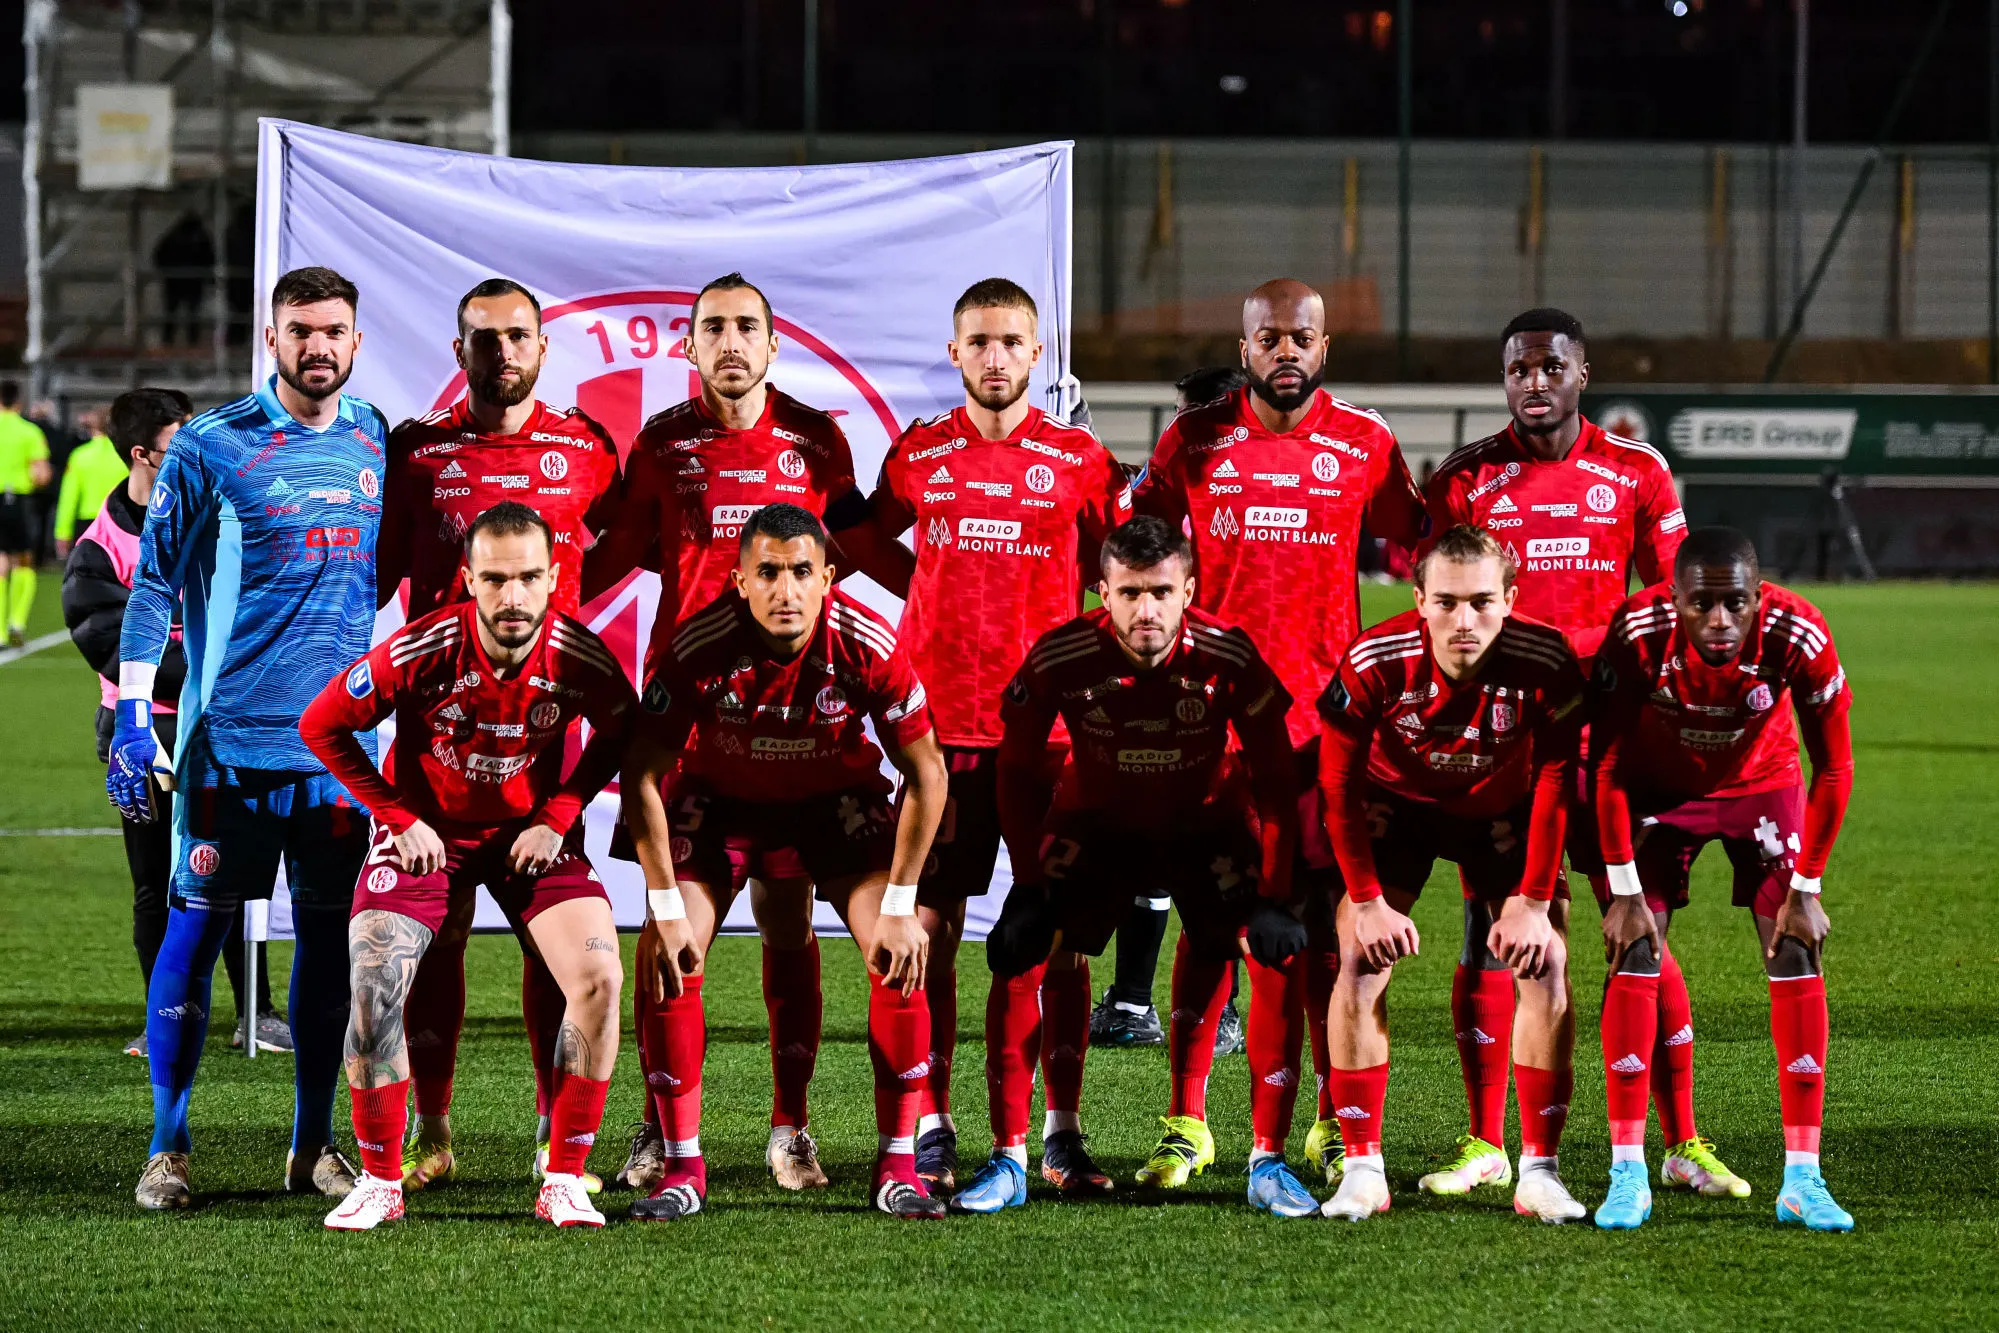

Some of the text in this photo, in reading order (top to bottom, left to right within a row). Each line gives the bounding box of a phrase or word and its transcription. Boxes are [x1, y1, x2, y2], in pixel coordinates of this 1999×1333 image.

[586, 315, 693, 364] 192
[530, 431, 594, 451] SOGIMM
[772, 427, 830, 458] SOGIMM
[1308, 432, 1369, 462] SOGIMM
[908, 441, 953, 461] E.Leclerc
[1020, 437, 1083, 467] SOGIMM
[1575, 459, 1638, 489] SOGIMM
[434, 487, 471, 500] Sysco
[537, 487, 572, 495] ANNECY
[675, 482, 708, 495] Sysco
[775, 483, 807, 494] ANNECY
[1208, 482, 1243, 497] Sysco
[1308, 487, 1342, 497] ANNECY
[923, 490, 956, 504] Sysco
[1020, 497, 1056, 509] ANNECY
[265, 504, 300, 517] Sysco
[1252, 510, 1300, 523] RADIO
[1487, 517, 1523, 531] Sysco
[1583, 515, 1618, 525] ANNECY
[966, 522, 1014, 535] RADIO
[1534, 541, 1581, 553] RADIO
[433, 722, 469, 737] Sysco
[759, 739, 808, 749] RADIO
[1126, 751, 1174, 761] RADIO
[475, 758, 522, 770] RADIO
[357, 1138, 384, 1152] didas
